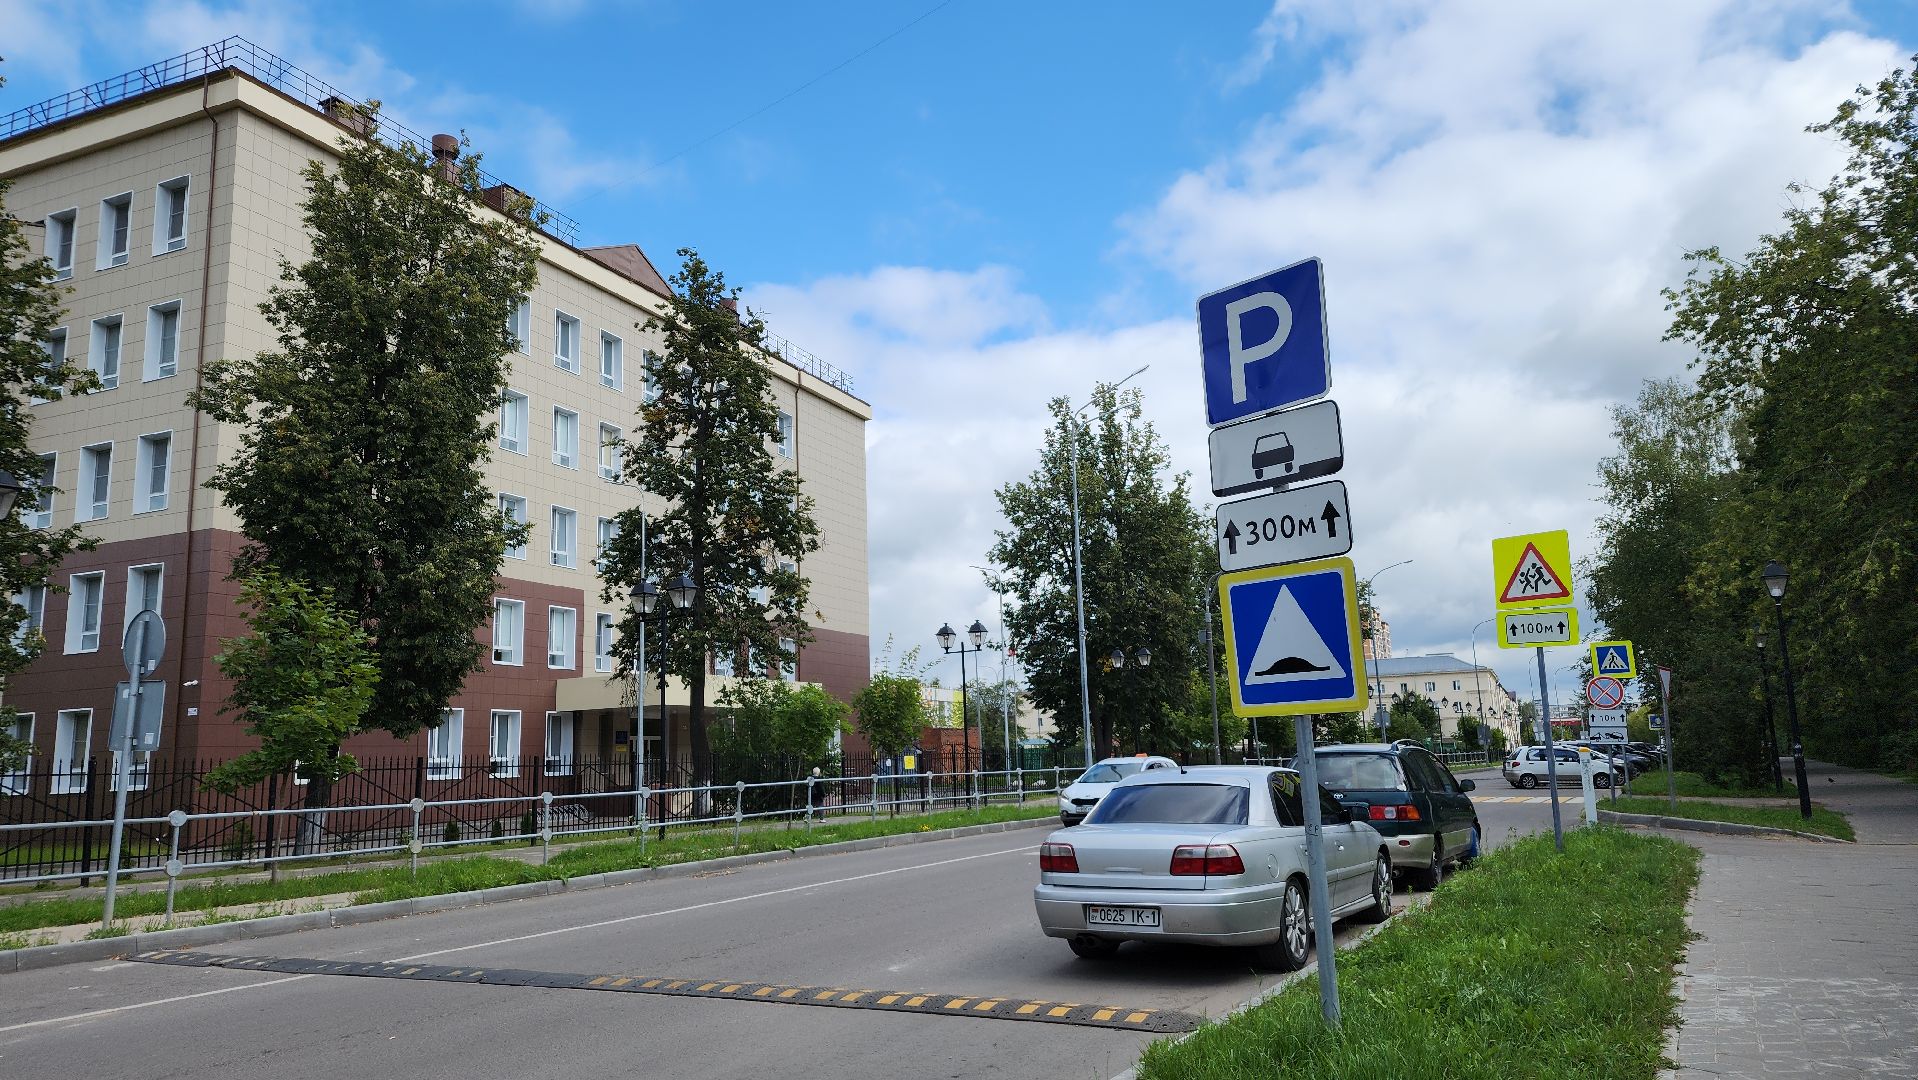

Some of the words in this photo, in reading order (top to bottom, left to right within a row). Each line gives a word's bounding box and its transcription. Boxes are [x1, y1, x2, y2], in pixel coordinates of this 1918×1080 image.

[1226, 291, 1293, 404] P
[1099, 908, 1125, 922] 0625
[1131, 910, 1156, 924] IK-1
